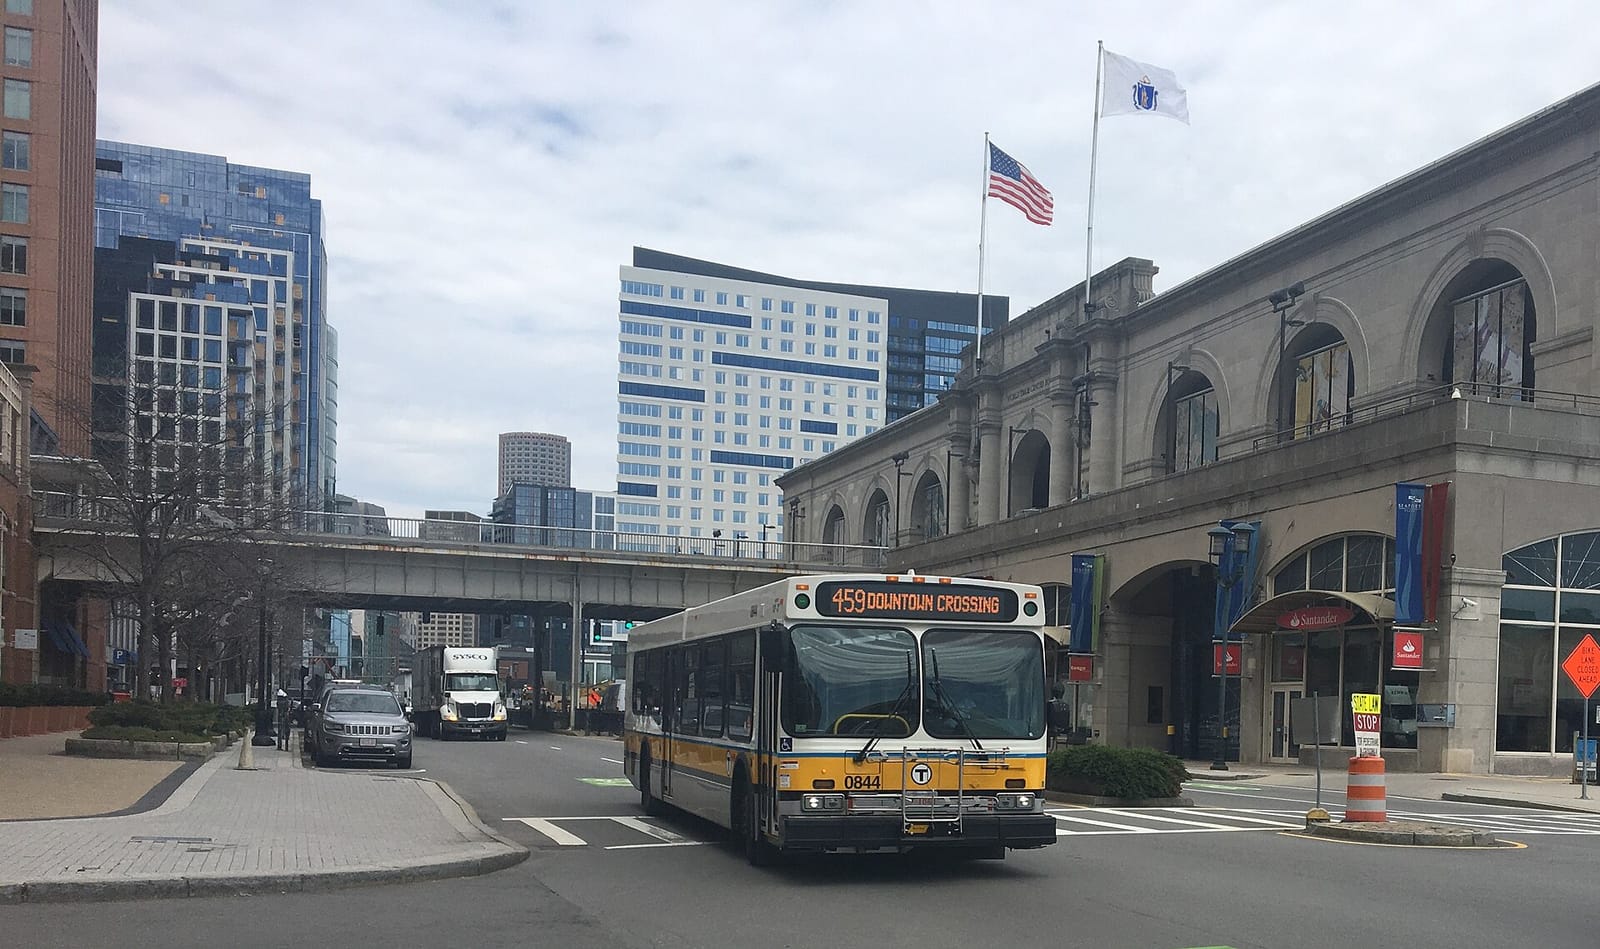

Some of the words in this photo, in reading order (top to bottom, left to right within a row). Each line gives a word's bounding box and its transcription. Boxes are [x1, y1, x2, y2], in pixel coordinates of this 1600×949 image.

[832, 588, 866, 613] 459
[867, 592, 934, 611] DOWNTOWN
[937, 595, 1000, 613] CROSSING
[1301, 612, 1338, 626] Santander
[116, 650, 123, 659] P
[1577, 666, 1599, 674] CLOSED
[1579, 676, 1597, 684] AHEAD
[1353, 695, 1367, 711] STATE
[1369, 695, 1379, 712] LAW
[1357, 715, 1377, 730] STOP
[844, 775, 881, 790] 0844
